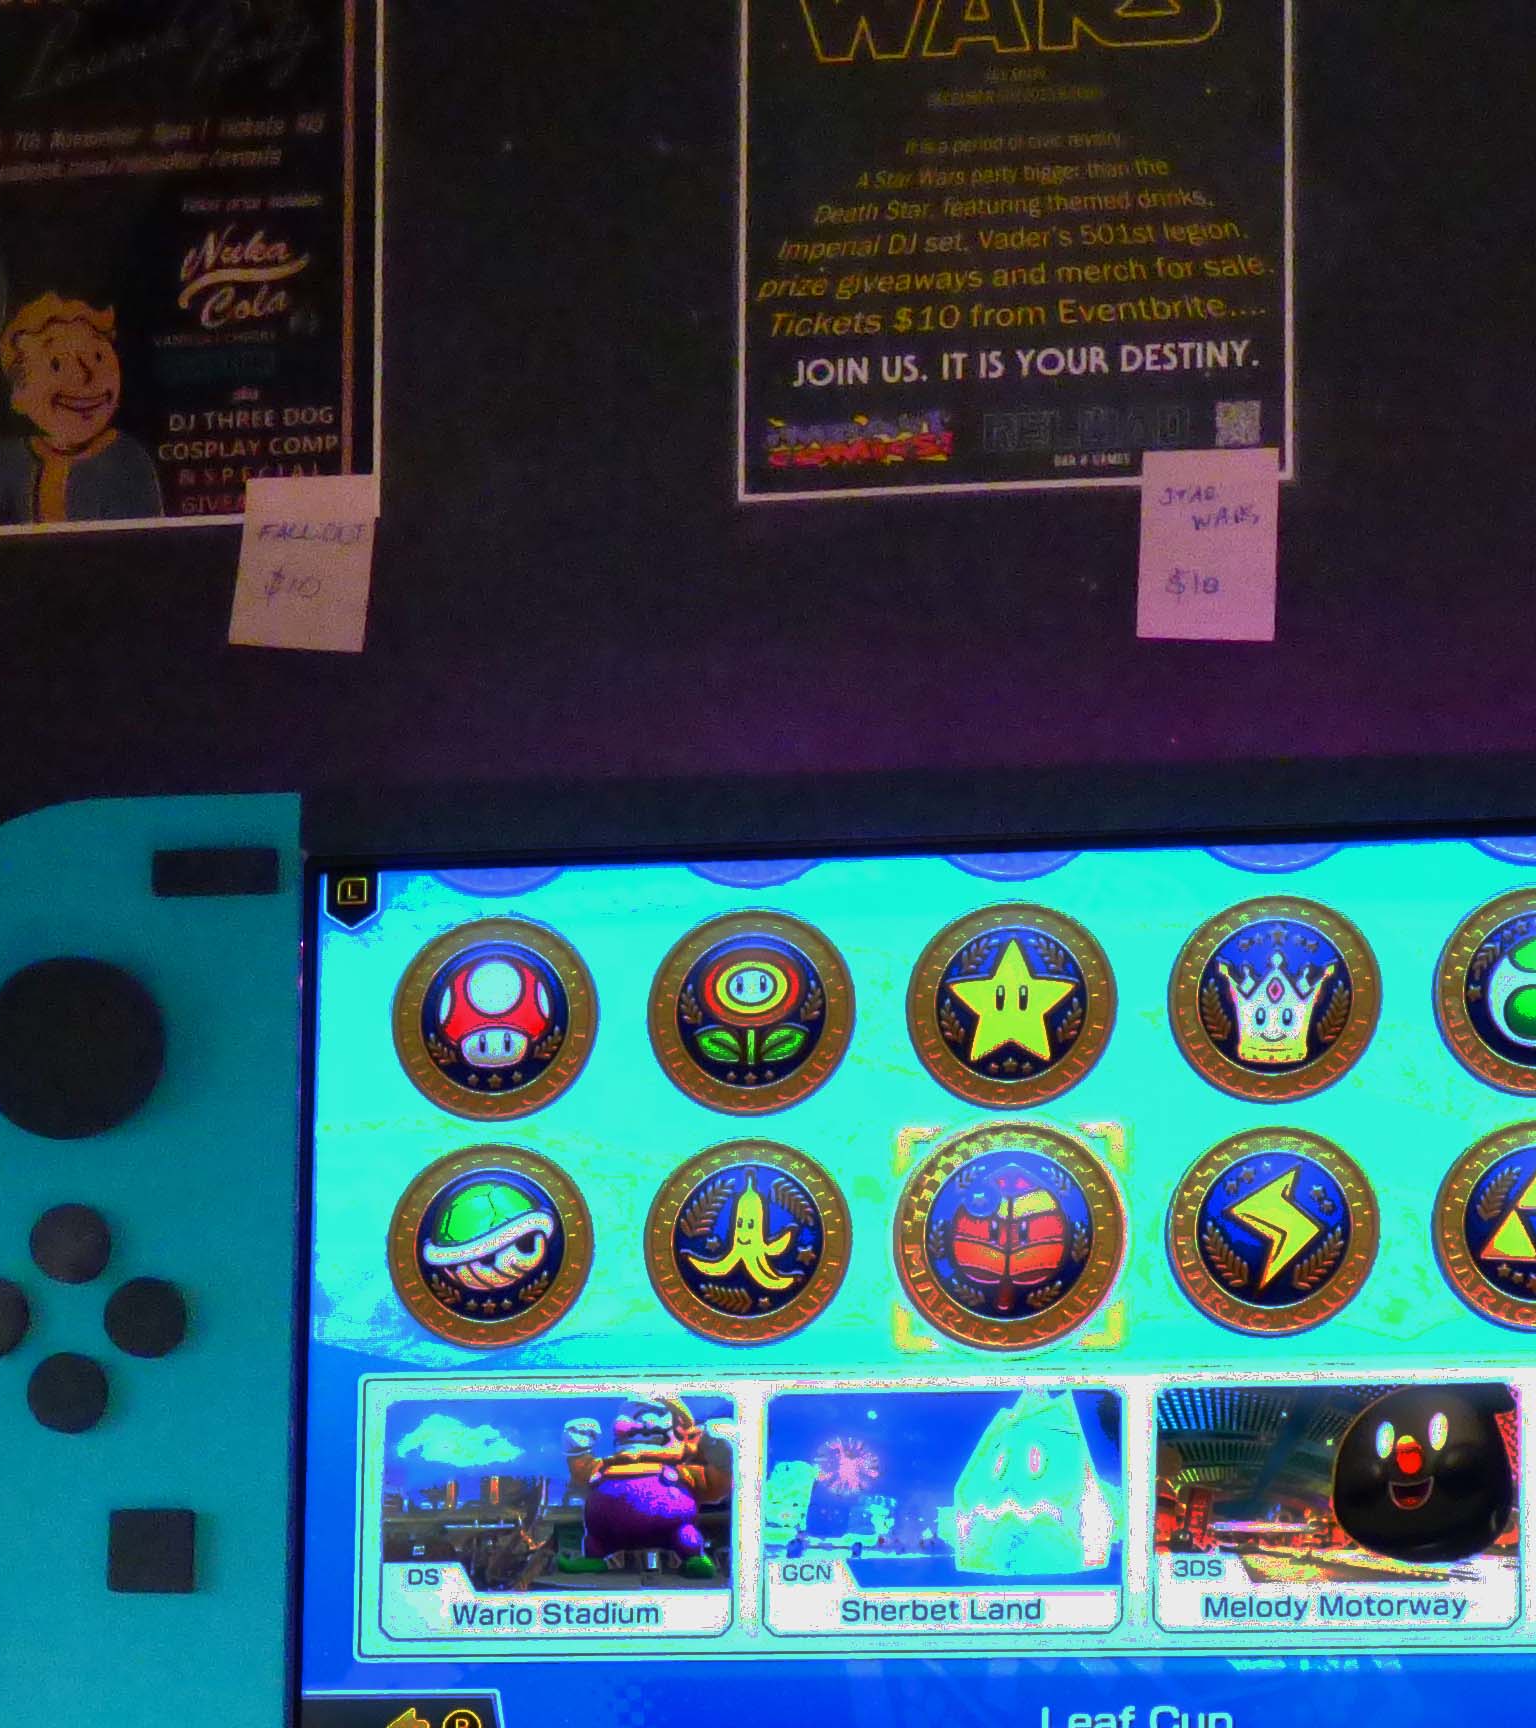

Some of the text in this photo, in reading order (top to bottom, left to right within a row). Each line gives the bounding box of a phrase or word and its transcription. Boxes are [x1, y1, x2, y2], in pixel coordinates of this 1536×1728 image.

[1134, 155, 1171, 177] the
[887, 230, 919, 257] DJ
[757, 272, 828, 303] prize
[835, 268, 984, 302] giveaways
[991, 260, 1047, 290] and
[1055, 256, 1148, 285] merch
[1154, 254, 1194, 283] for
[769, 308, 884, 338] Tickets
[894, 303, 962, 334] $10
[967, 302, 1047, 329] from
[792, 338, 1260, 388] JOIN US. IT IS YOUR DESTINY.
[168, 406, 335, 432] DJ THREE DOG
[158, 435, 339, 462] COSPLAY COMP
[406, 1567, 440, 1587] DS
[781, 1563, 832, 1582] GCN
[1173, 1559, 1223, 1578] 3DS
[452, 1601, 659, 1627] Wario Stadium
[841, 1598, 1041, 1622] Sherbet Land
[1203, 1594, 1467, 1621] Melody Motorway
